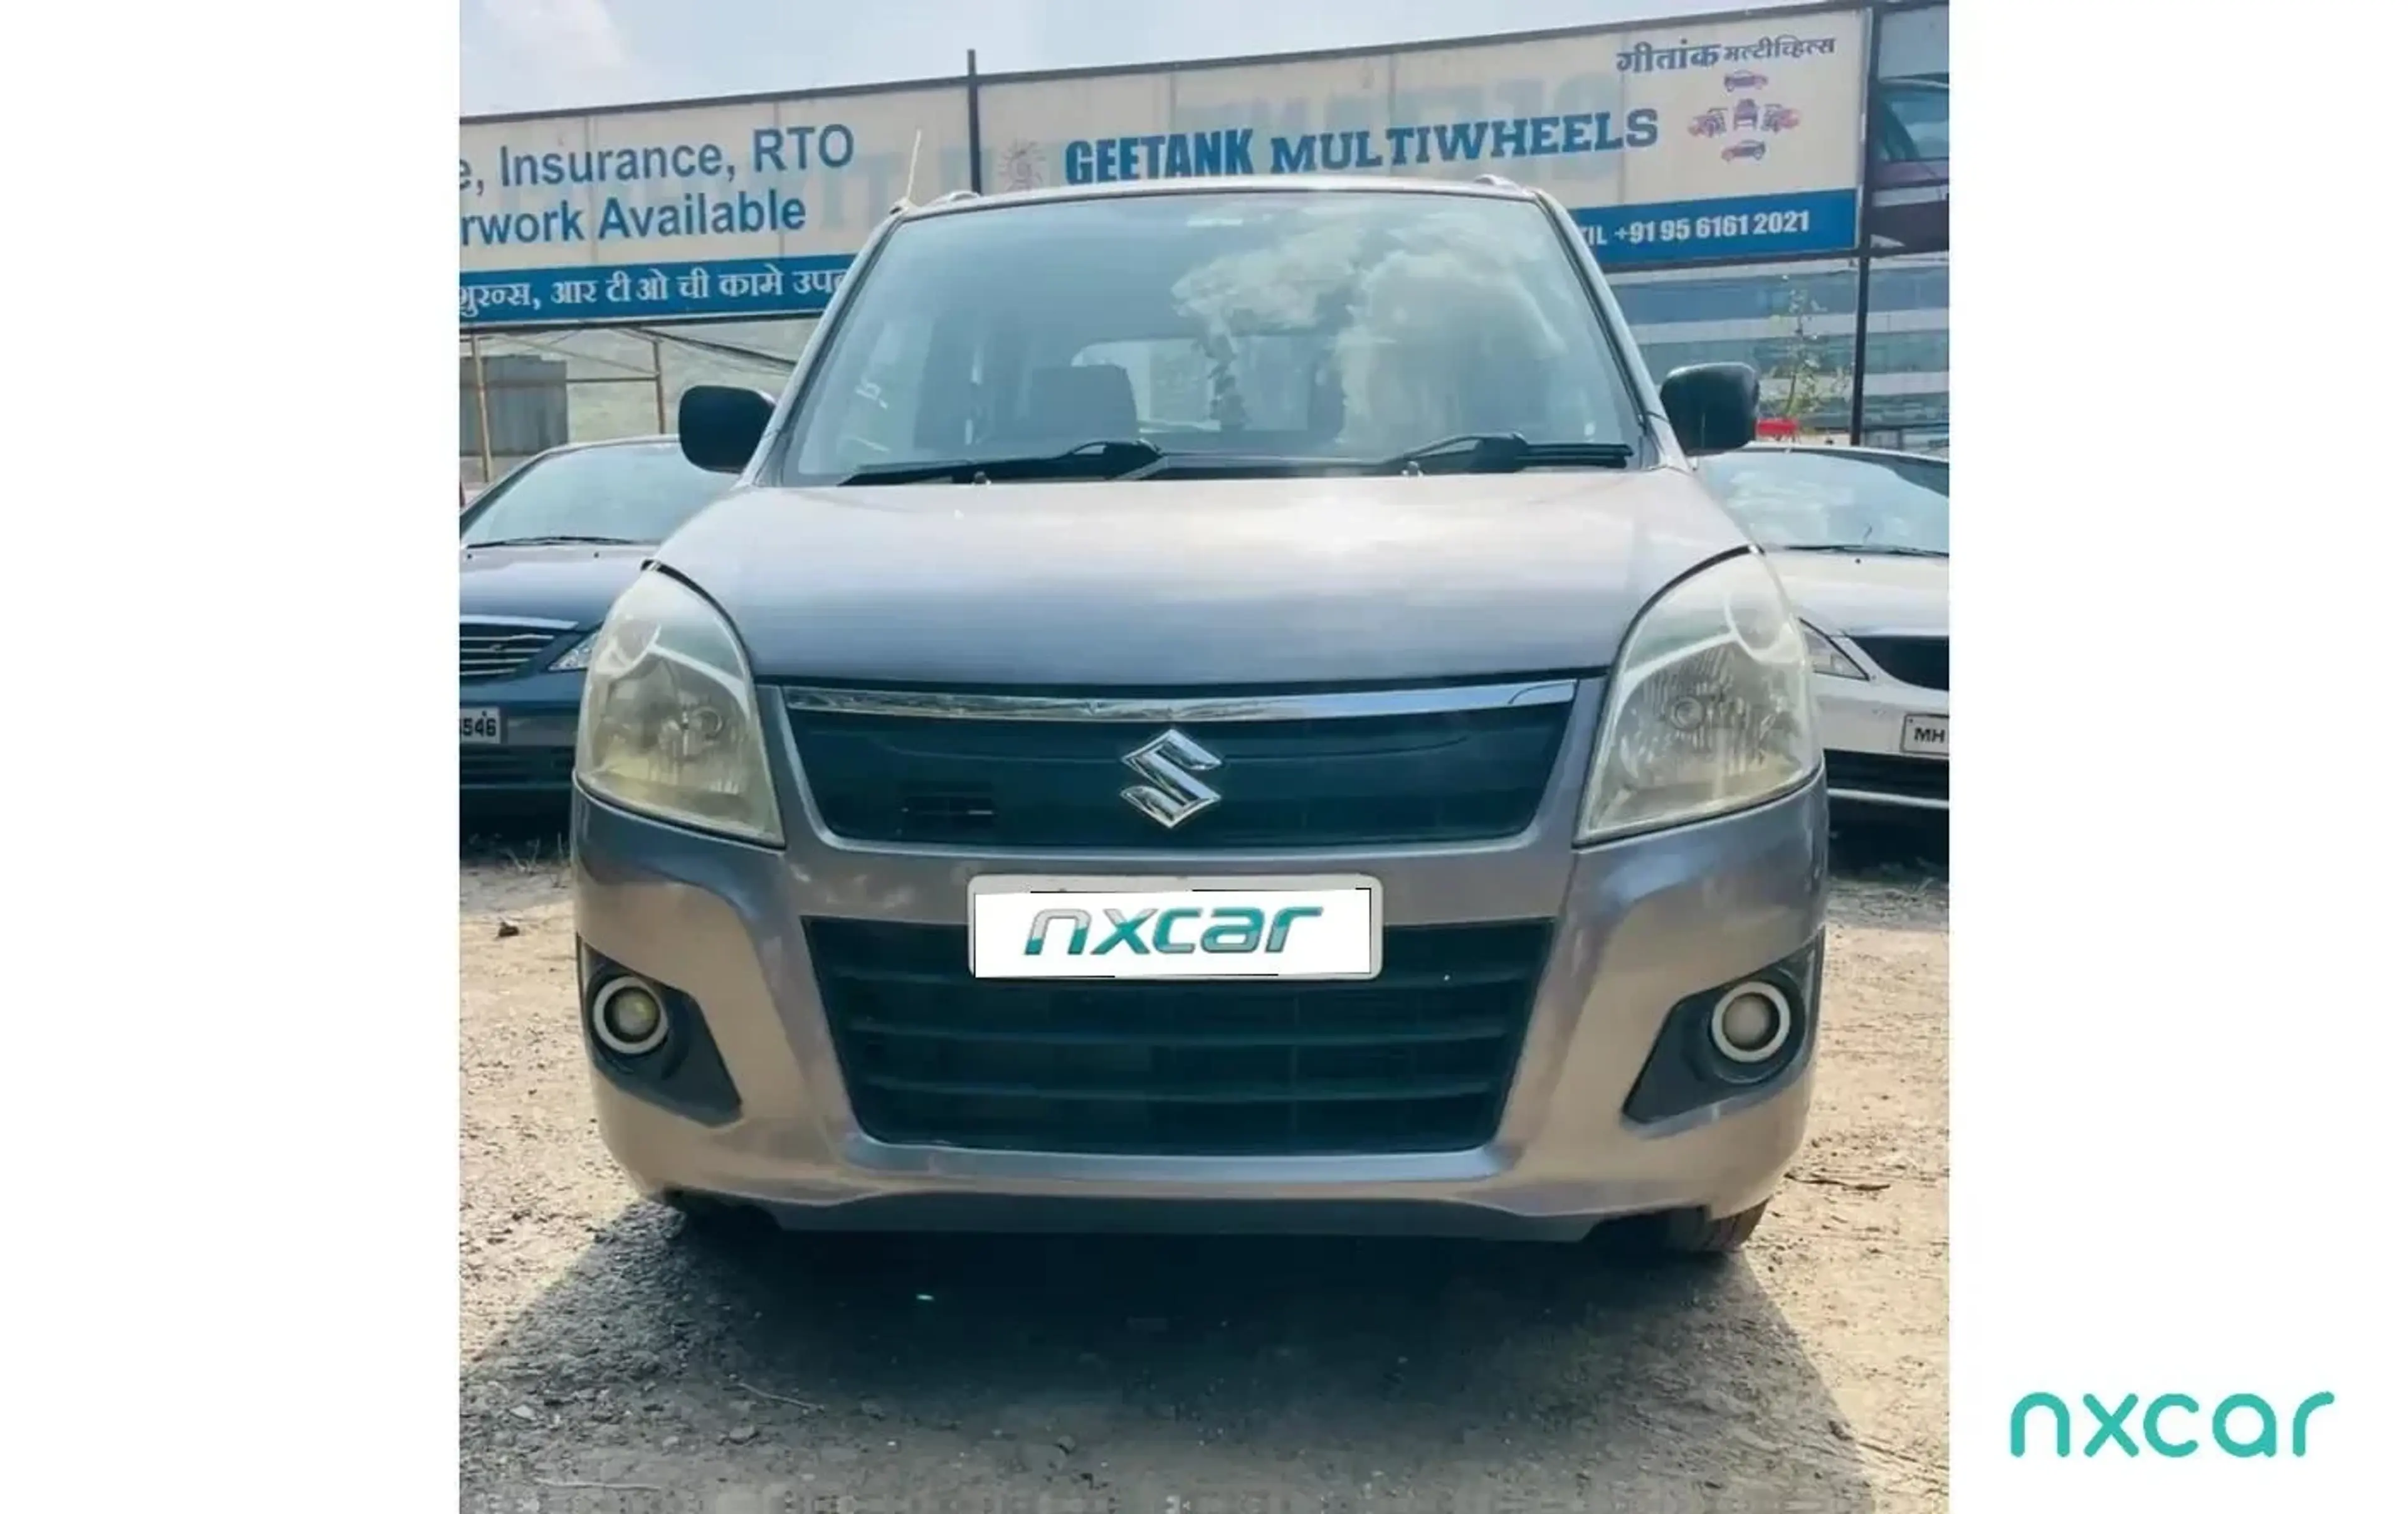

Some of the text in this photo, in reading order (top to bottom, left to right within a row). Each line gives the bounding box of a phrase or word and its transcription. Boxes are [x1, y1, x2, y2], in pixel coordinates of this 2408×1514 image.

[1616, 38, 1722, 73] गीतांक
[500, 142, 736, 188] Insurance,
[752, 124, 855, 174] RTO
[1065, 108, 1658, 185] GEETANK MULTIWHEELS
[461, 199, 586, 246] rwork
[598, 188, 806, 241] Available
[550, 280, 599, 304] आर
[605, 270, 631, 303] टी
[635, 268, 670, 302] ओ
[676, 267, 710, 299] ची
[718, 262, 785, 298] कामे
[1914, 727, 1945, 744] MH
